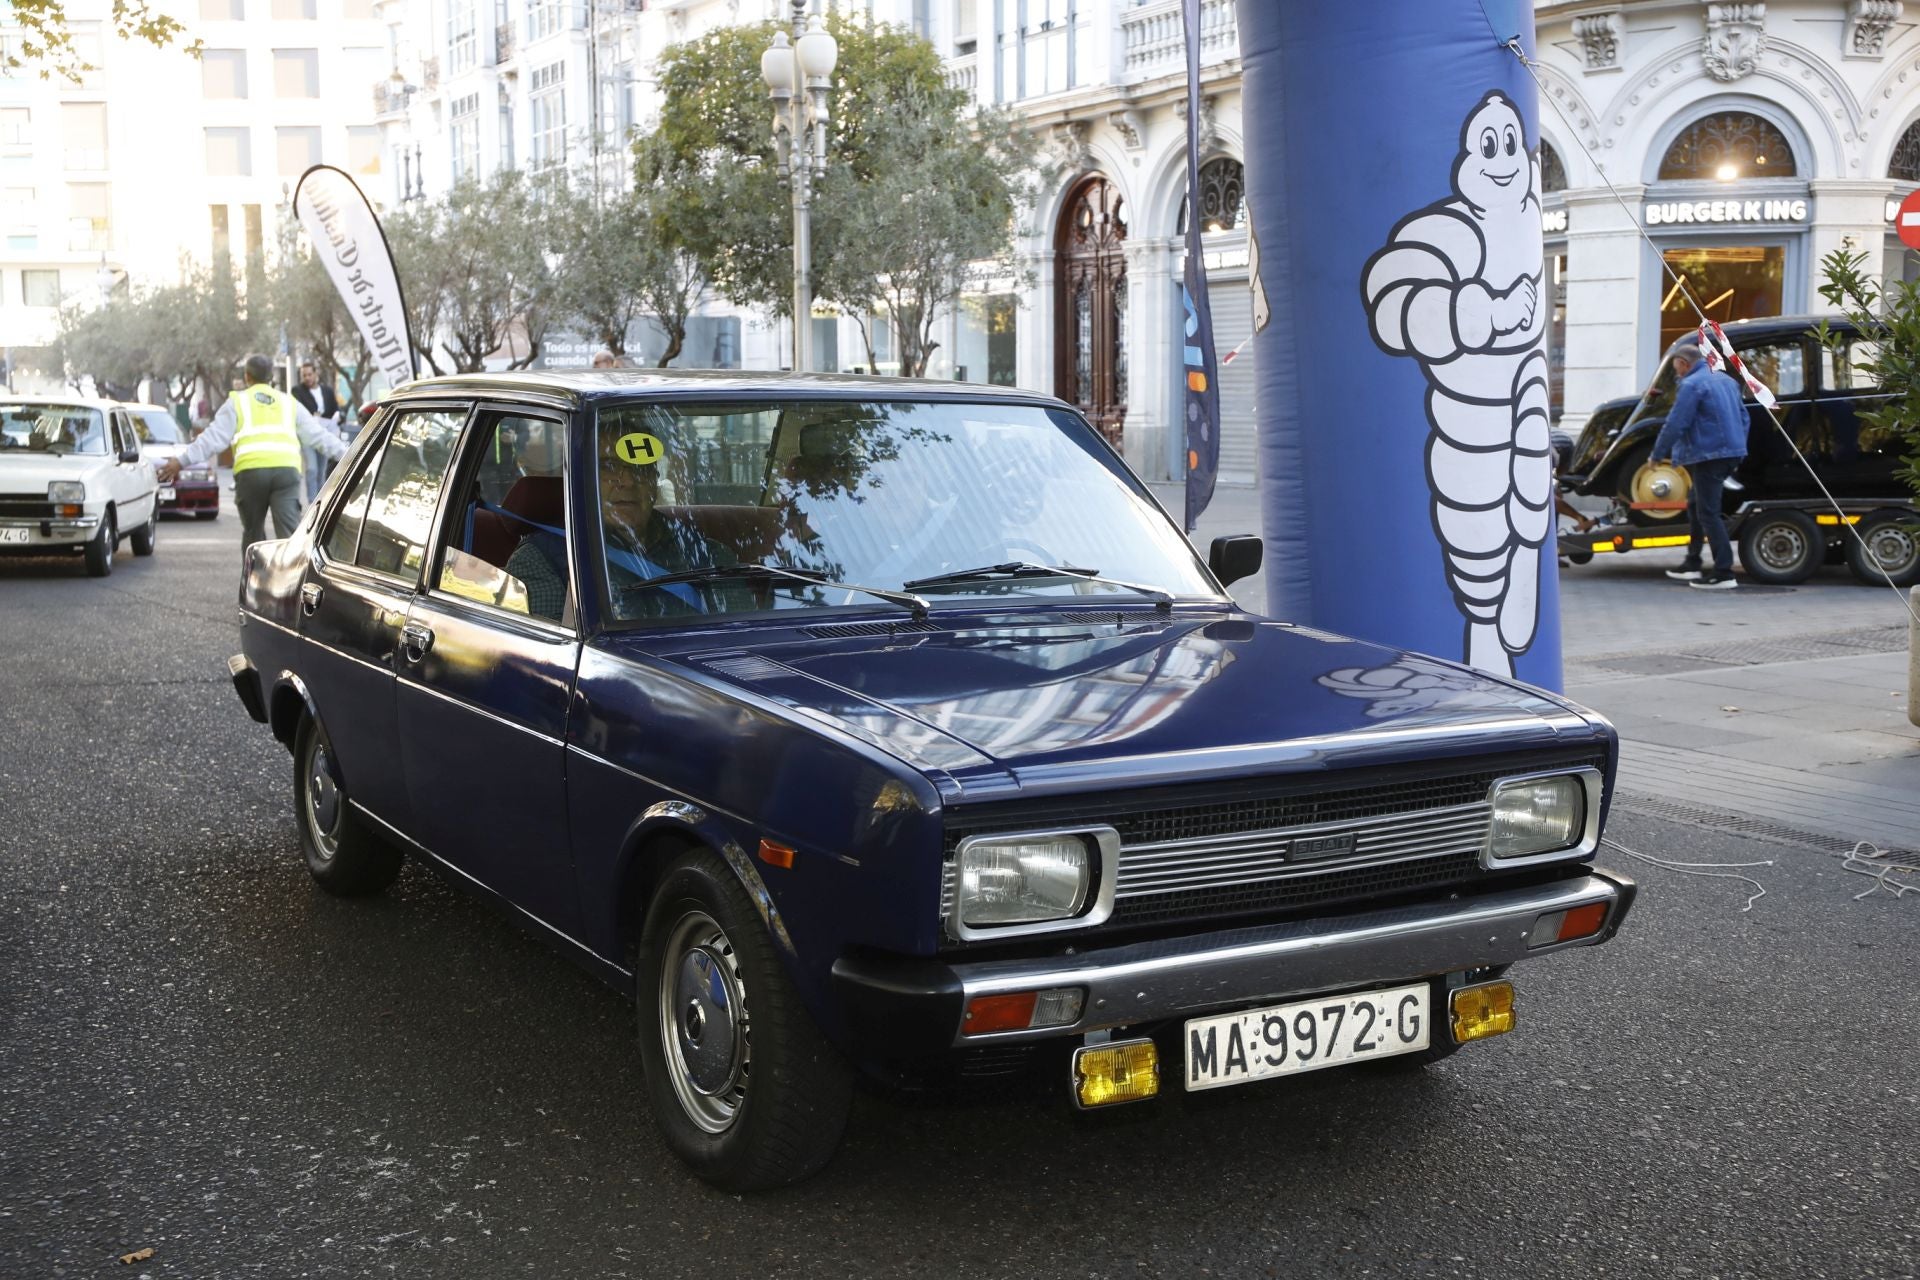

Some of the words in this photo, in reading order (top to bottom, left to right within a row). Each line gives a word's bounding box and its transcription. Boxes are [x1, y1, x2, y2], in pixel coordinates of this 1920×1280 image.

[1645, 201, 1742, 224] BURGER
[1744, 200, 1807, 221] KING
[544, 342, 572, 353] Todo
[574, 345, 589, 353] es
[544, 355, 587, 366] cuando
[624, 437, 655, 459] H
[1296, 837, 1350, 854] SEAT
